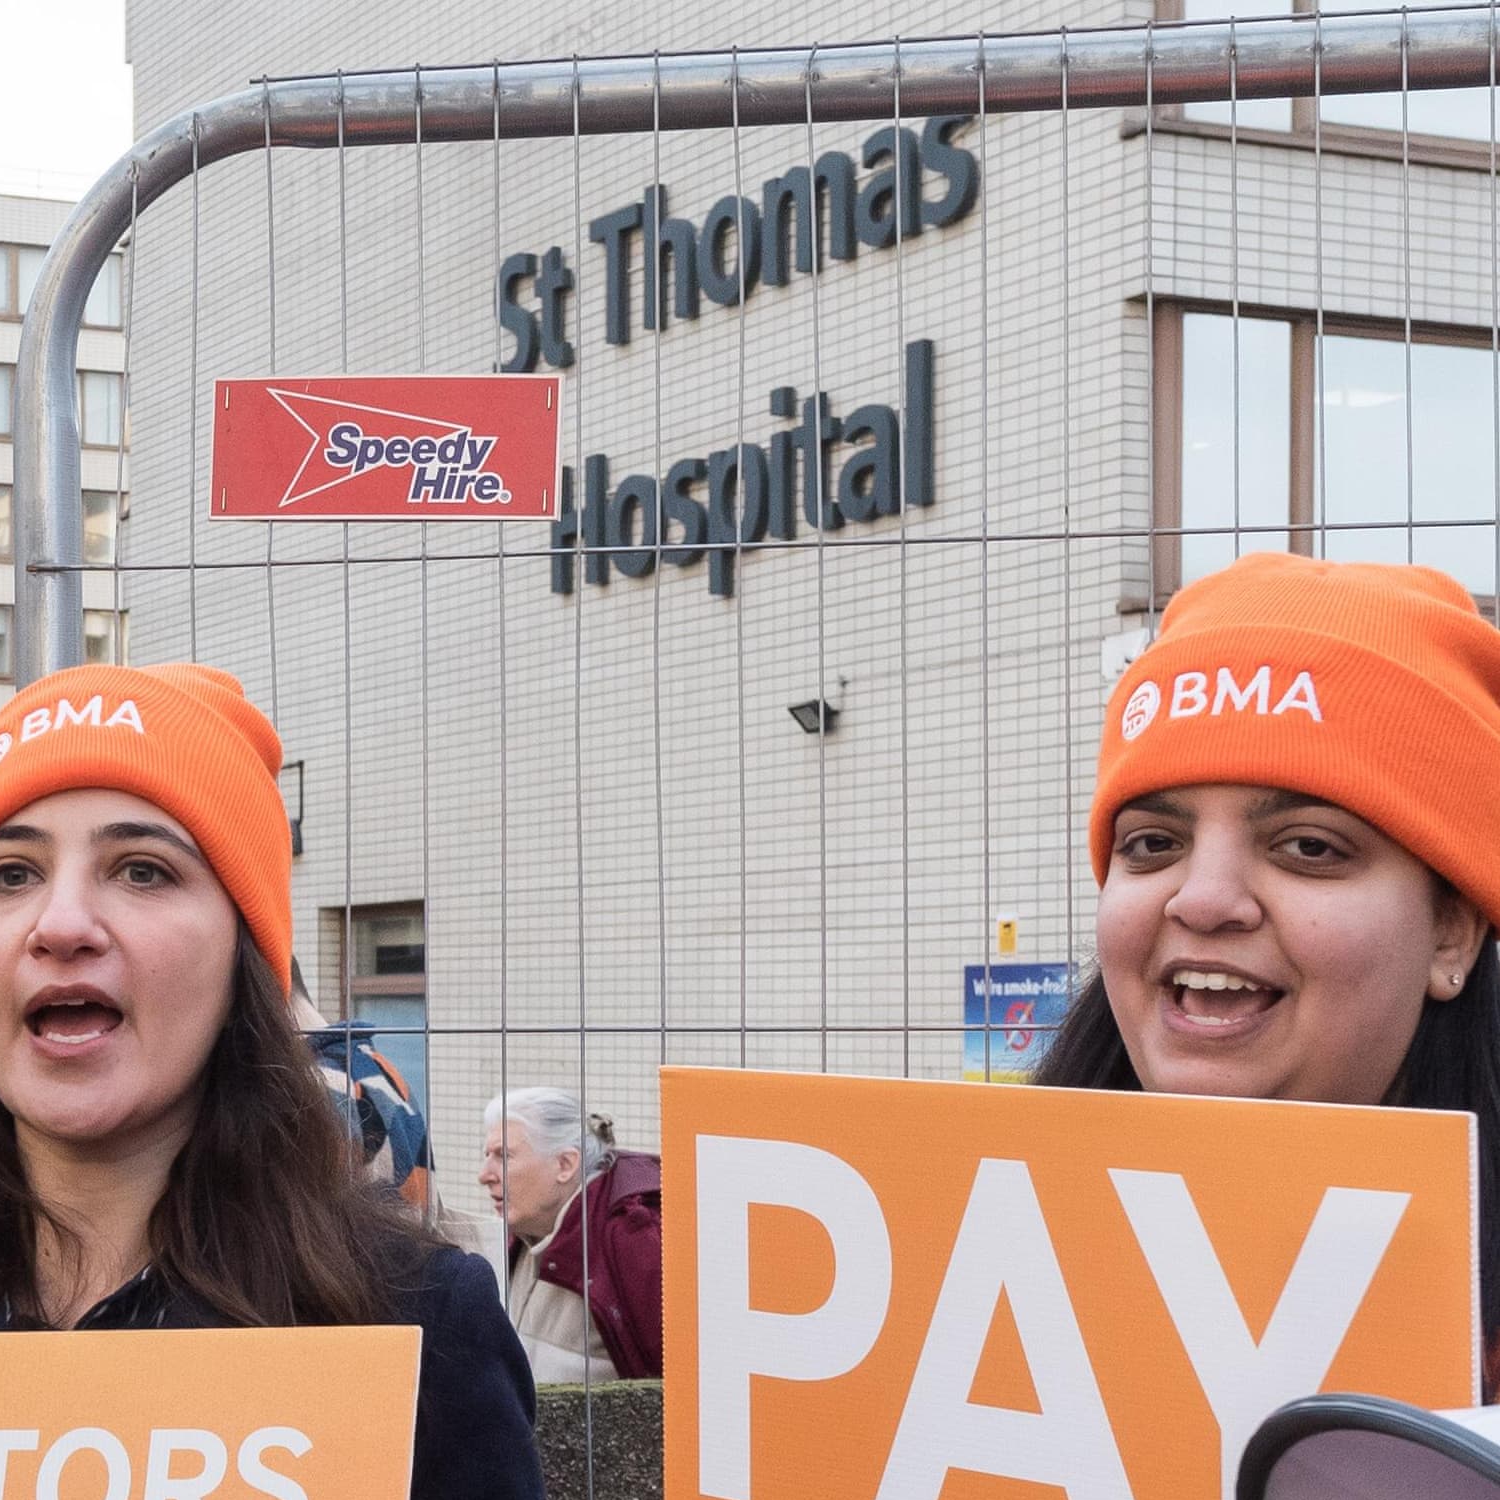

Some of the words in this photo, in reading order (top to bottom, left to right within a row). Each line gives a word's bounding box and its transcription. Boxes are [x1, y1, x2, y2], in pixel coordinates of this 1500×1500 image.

[494, 246, 575, 373] St
[589, 115, 979, 346] Thomas
[325, 423, 496, 474] Speedy
[550, 338, 935, 597] Hospital
[20, 695, 145, 743] BMA
[1169, 664, 1324, 723] BMA
